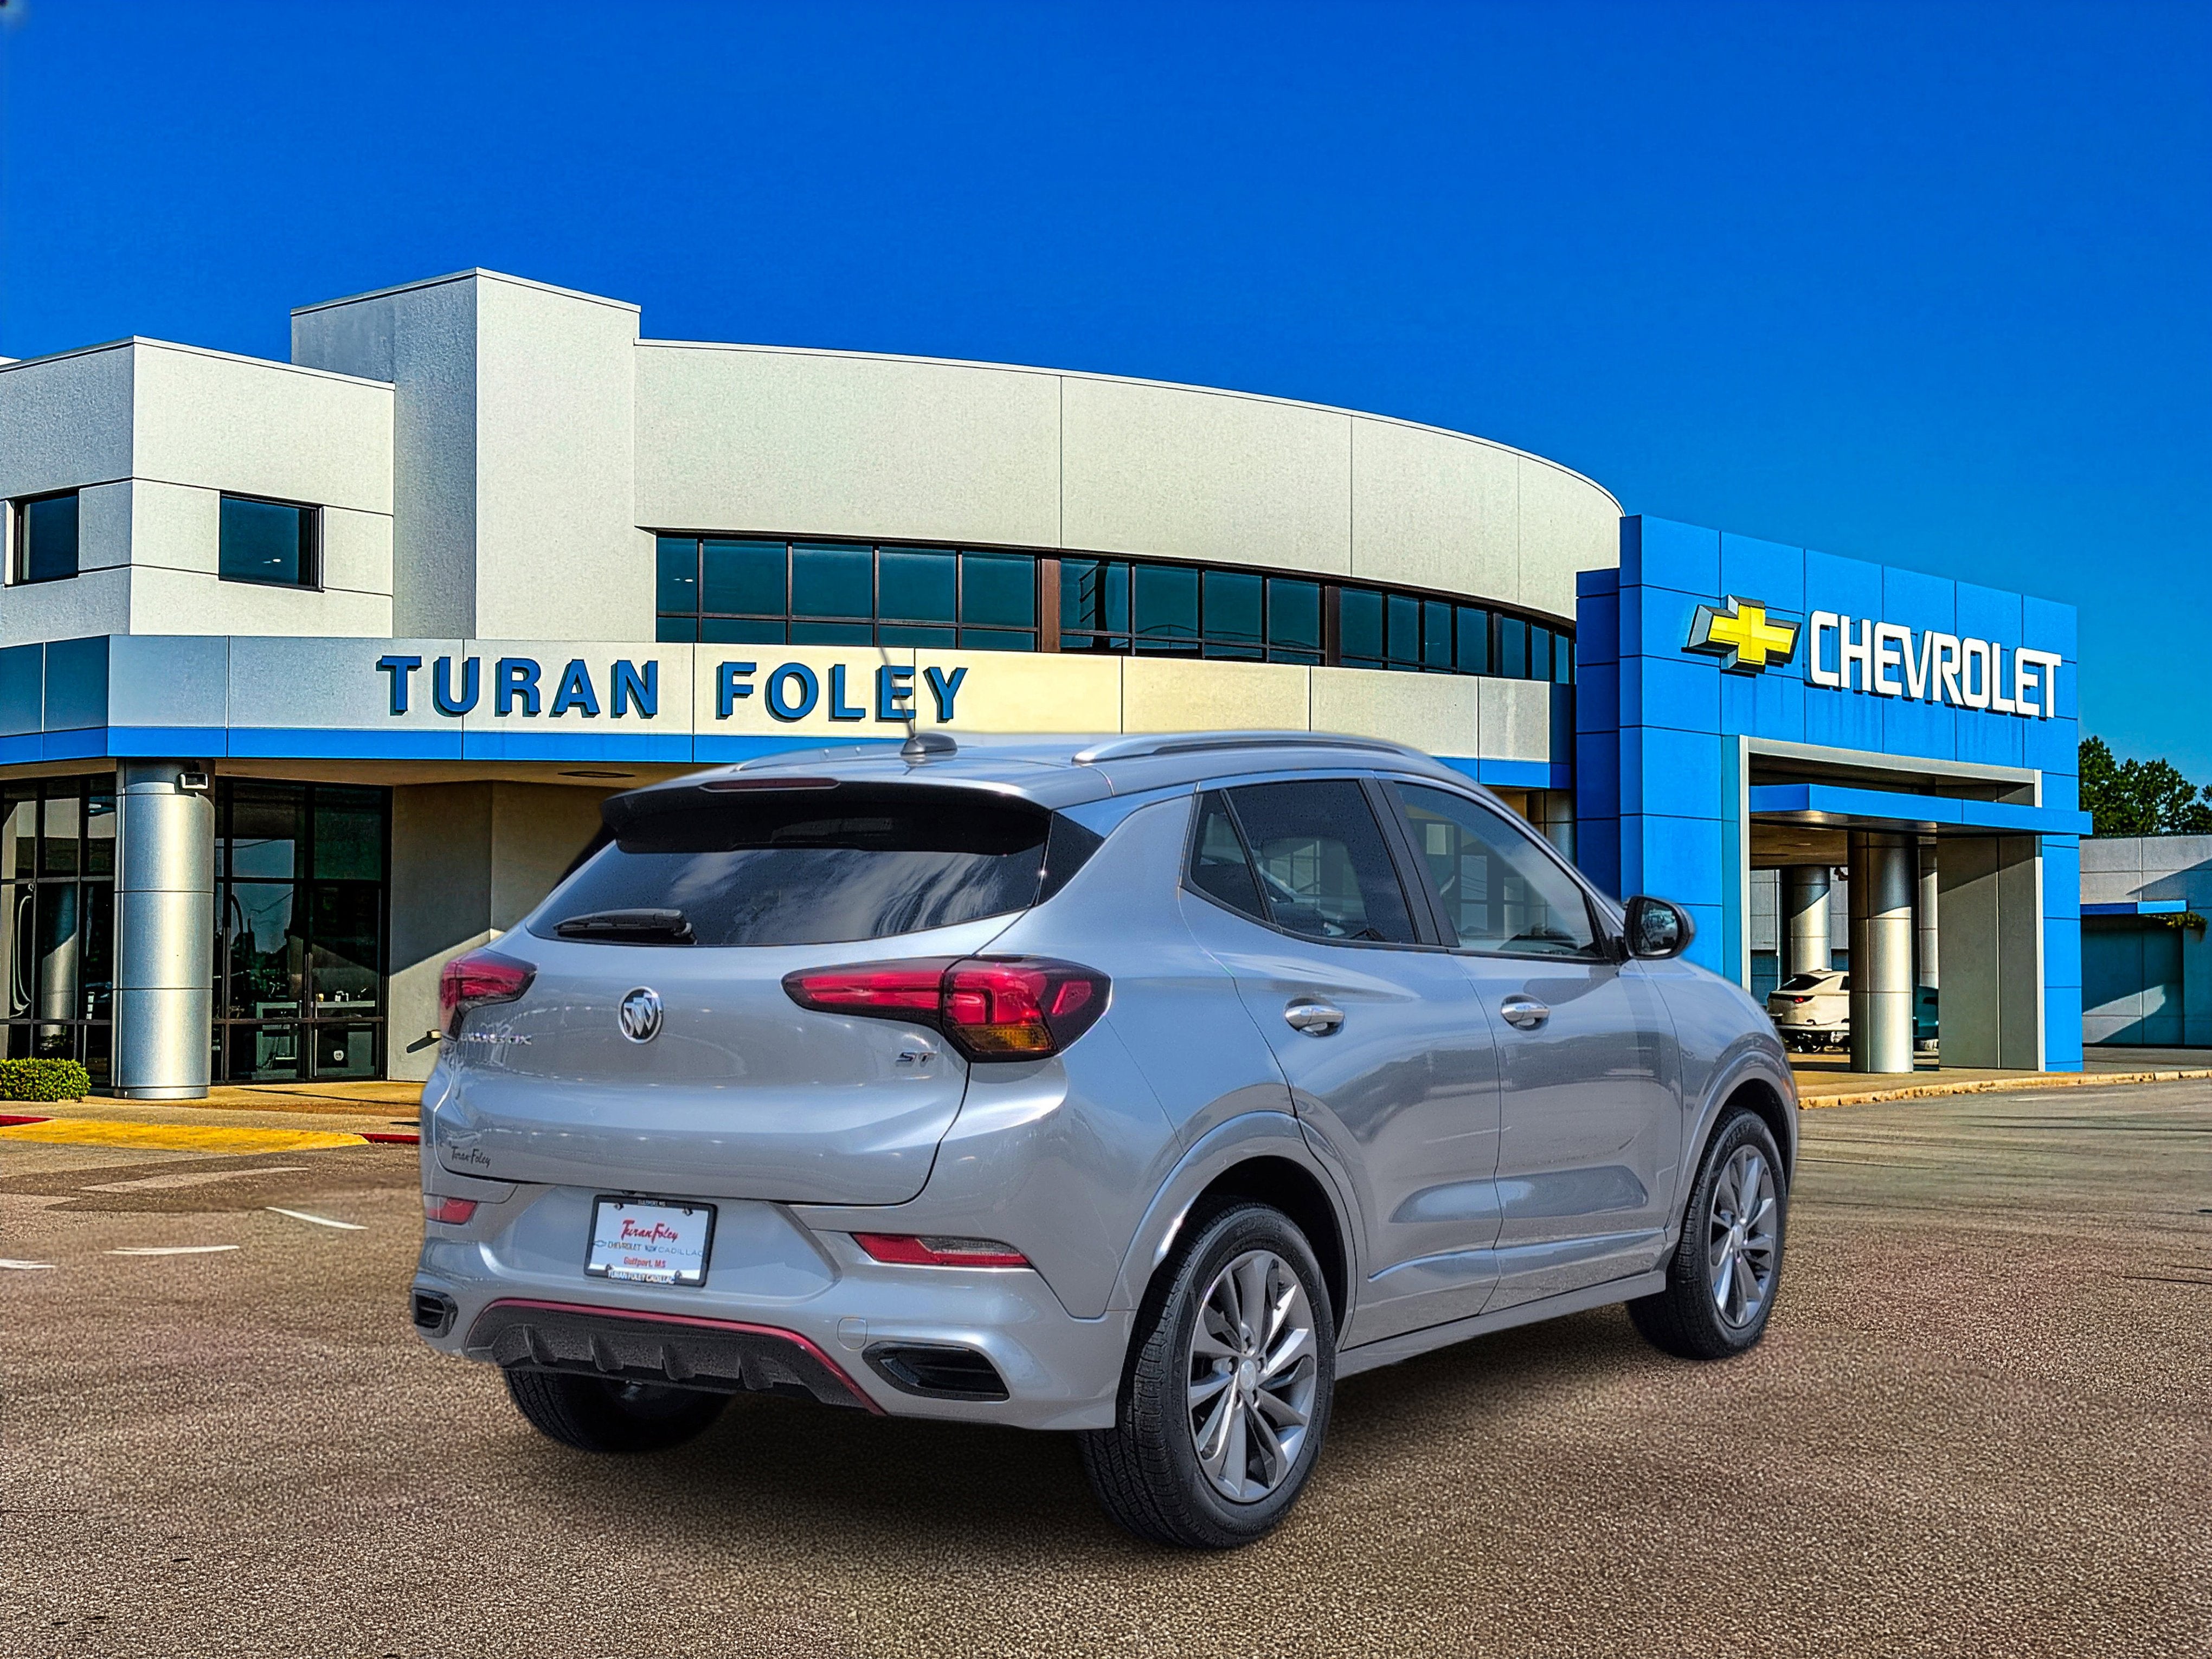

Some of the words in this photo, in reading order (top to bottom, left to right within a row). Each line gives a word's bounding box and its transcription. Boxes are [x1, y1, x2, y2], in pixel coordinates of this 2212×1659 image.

[1810, 609, 2062, 718] CHEVROLET
[376, 655, 658, 718] TURAN
[717, 661, 968, 724] FOLEY
[895, 1051, 937, 1068] ST
[608, 1241, 642, 1251] CHEVROLET
[658, 1246, 703, 1257] CADILLAC
[654, 1258, 667, 1268] MS
